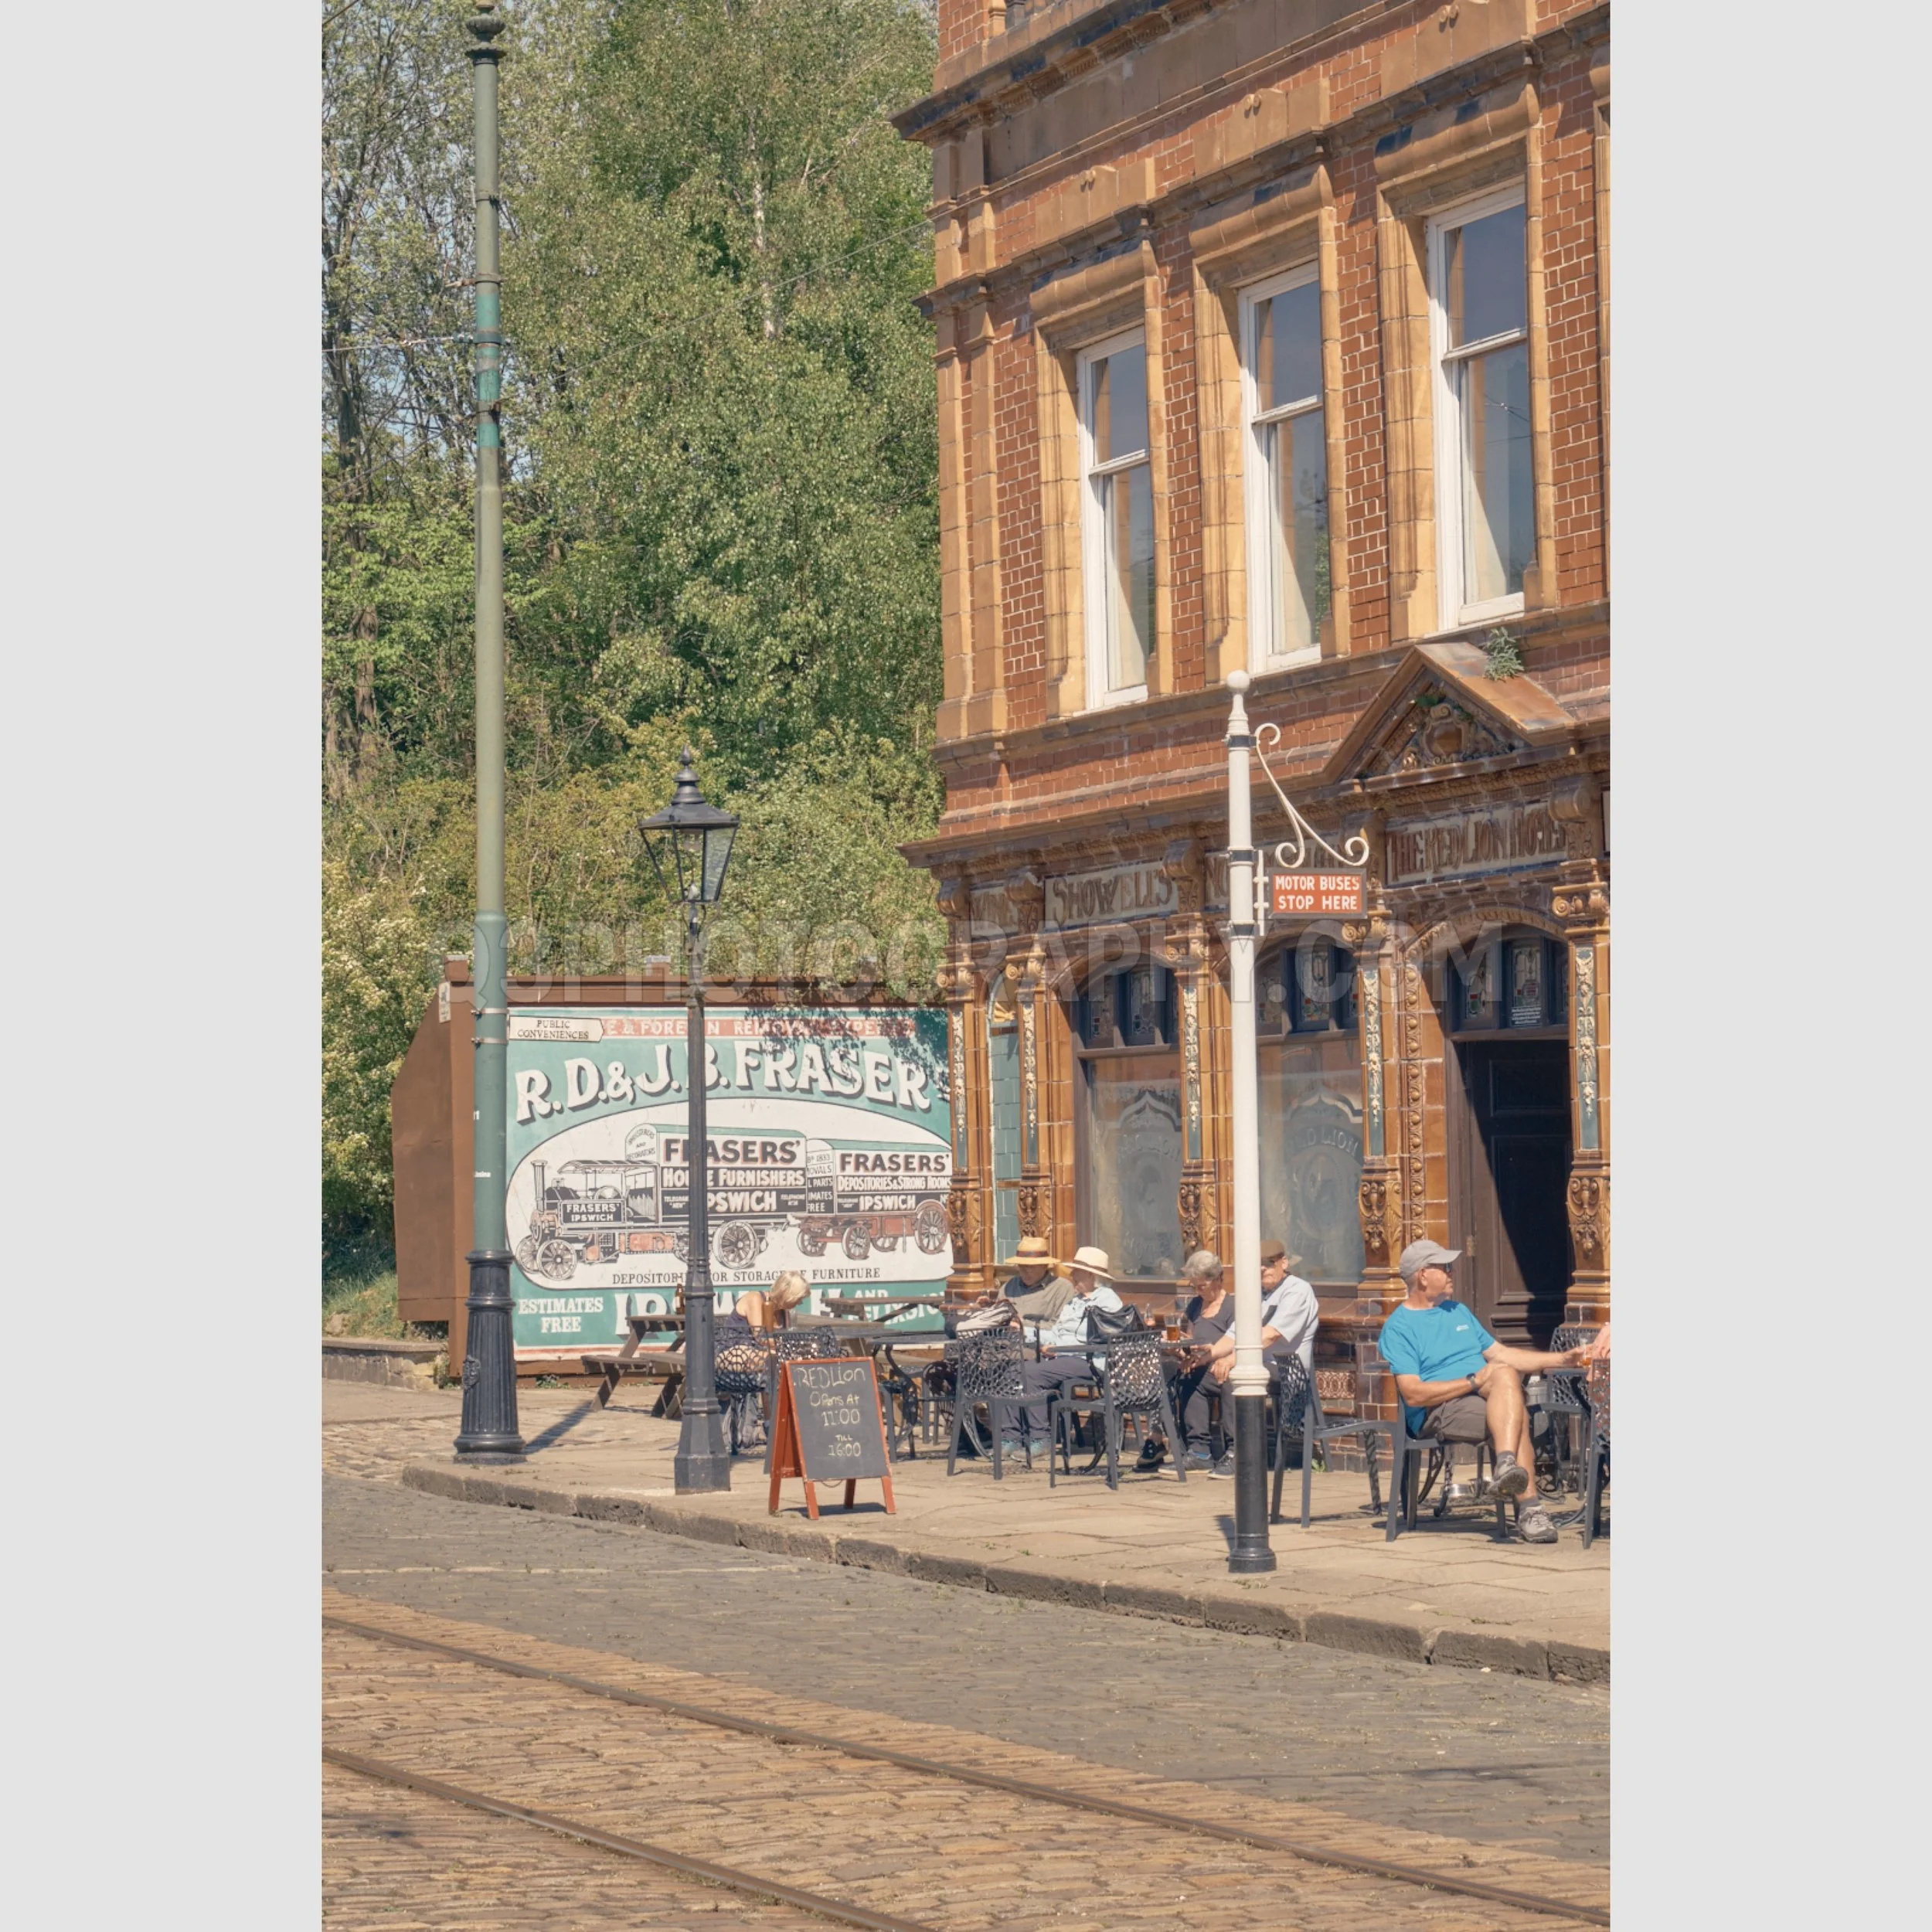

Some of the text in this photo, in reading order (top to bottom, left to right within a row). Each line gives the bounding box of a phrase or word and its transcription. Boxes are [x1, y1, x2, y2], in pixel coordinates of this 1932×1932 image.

[1275, 876, 1360, 891] MOTOR BUSES
[1278, 896, 1358, 910] STOP HERE
[536, 1019, 570, 1029] PUBLIC
[641, 1019, 719, 1036] FOREN
[517, 1029, 589, 1040] CONVENIENCES
[734, 1039, 932, 1113] FRASER
[663, 1138, 801, 1165] FASERS'
[839, 1153, 950, 1173] FRASERS'
[663, 1168, 804, 1188] HOE FURNISHERS
[813, 1178, 833, 1187] PARTS
[566, 1203, 619, 1213] FRASERS'
[706, 1190, 777, 1213] PSWICH
[859, 1194, 916, 1212] IPSWICH
[571, 1213, 614, 1222] IPSWICH
[612, 1273, 688, 1284] DEPOSITORI
[713, 1272, 727, 1282] OR
[812, 1268, 880, 1279] FURNITURE
[518, 1297, 604, 1315] ESTIMATES
[540, 1316, 582, 1333] FREE
[821, 1408, 860, 1427] 11:00
[828, 1442, 861, 1457] 16:00
